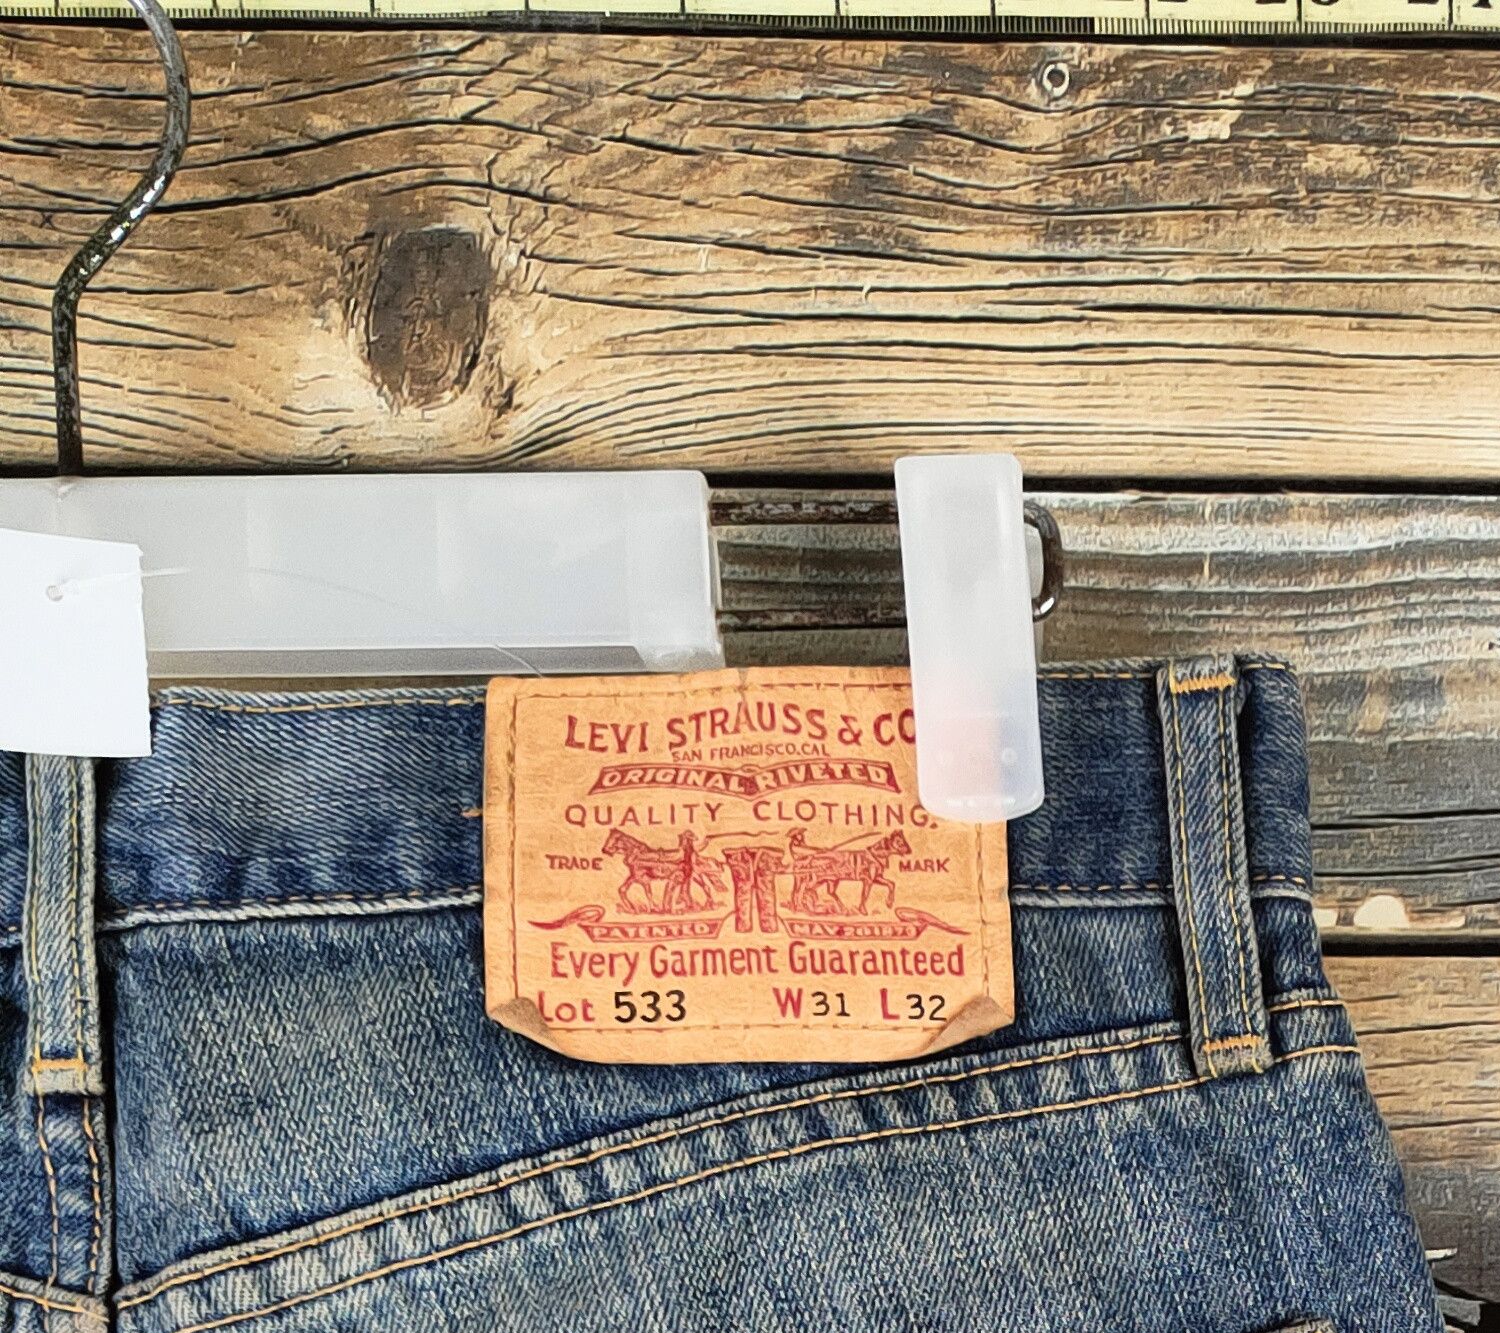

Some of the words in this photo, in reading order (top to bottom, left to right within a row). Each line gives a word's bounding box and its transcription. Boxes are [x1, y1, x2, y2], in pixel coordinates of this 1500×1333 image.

[564, 714, 649, 754] LEVI
[666, 701, 828, 751] STRAUSS
[837, 713, 863, 746] &
[671, 750, 702, 763] SAN
[601, 767, 746, 793] ORIGINAL
[754, 762, 889, 792] RIVETED
[564, 802, 723, 828] QUALITY
[752, 800, 938, 829] CLOTHING.
[545, 854, 603, 870] TRADE
[899, 857, 950, 873] MARK
[591, 921, 710, 939] PATENTED
[551, 942, 639, 987] Every
[649, 944, 779, 979] Garment
[788, 941, 965, 977] Guaranteed
[538, 990, 595, 1023] Lot
[613, 989, 687, 1024] 533
